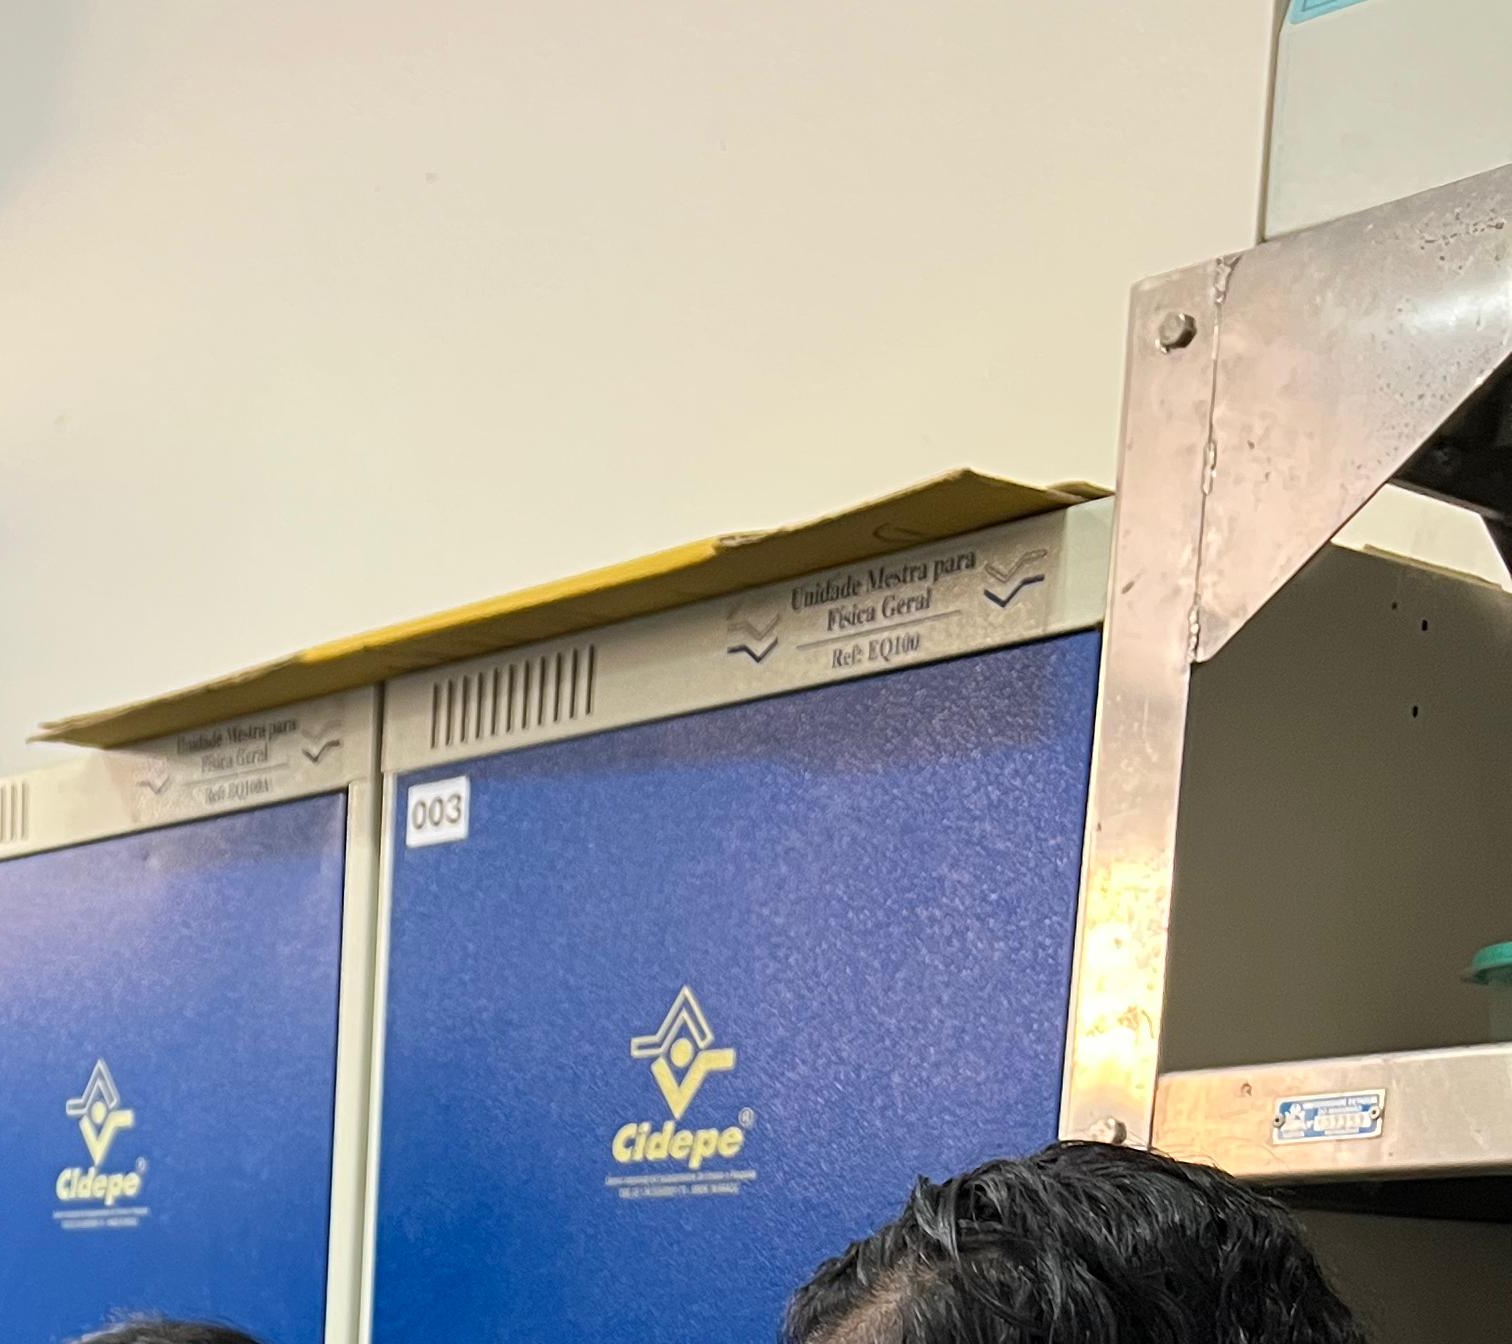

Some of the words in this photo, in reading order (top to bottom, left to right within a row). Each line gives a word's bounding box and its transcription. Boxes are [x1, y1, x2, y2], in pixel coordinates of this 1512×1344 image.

[791, 576, 862, 611] Unidade
[867, 562, 928, 592] Mestra
[932, 551, 977, 583] para
[881, 587, 933, 619] Geral
[868, 633, 920, 661] EQ100
[412, 793, 462, 830] 003
[611, 1120, 744, 1169] Cidepe
[56, 1166, 141, 1206] Cidepe
